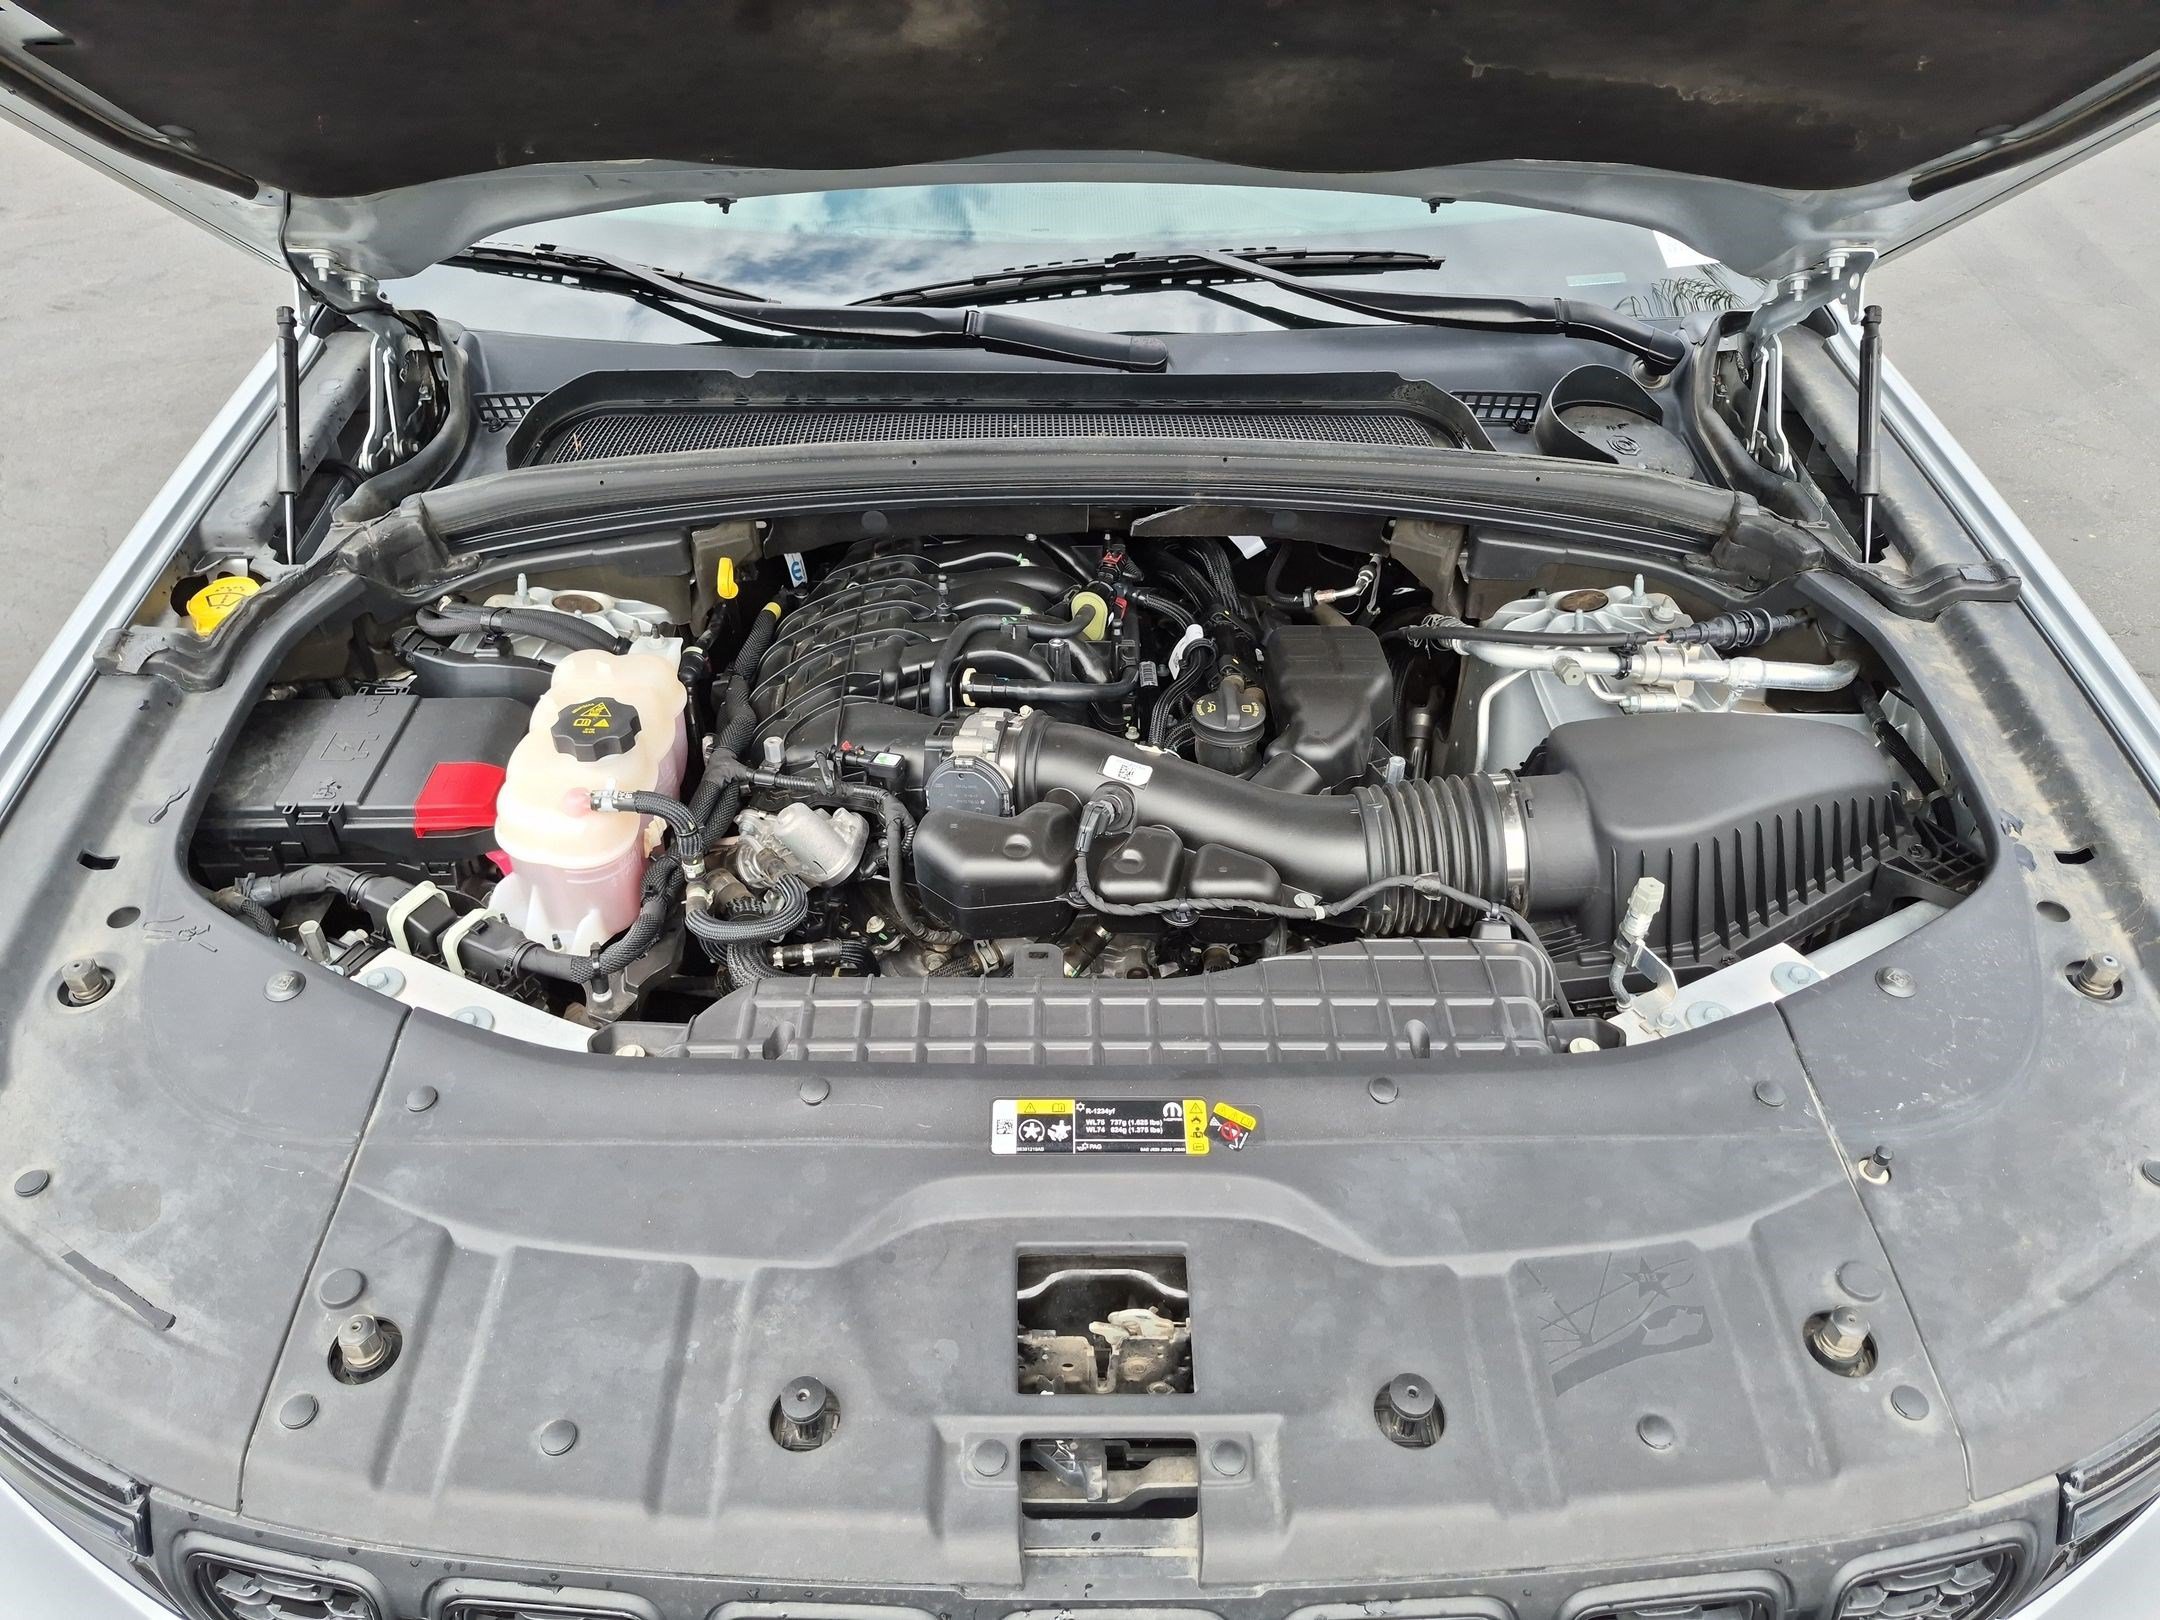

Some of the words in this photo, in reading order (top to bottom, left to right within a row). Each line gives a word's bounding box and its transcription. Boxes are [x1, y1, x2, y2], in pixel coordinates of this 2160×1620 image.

[1085, 1107, 1116, 1116] R-1234yf
[1110, 1119, 1127, 1127] 737g
[1149, 1118, 1163, 1127] lbs)
[1149, 1126, 1163, 1135] lbs)
